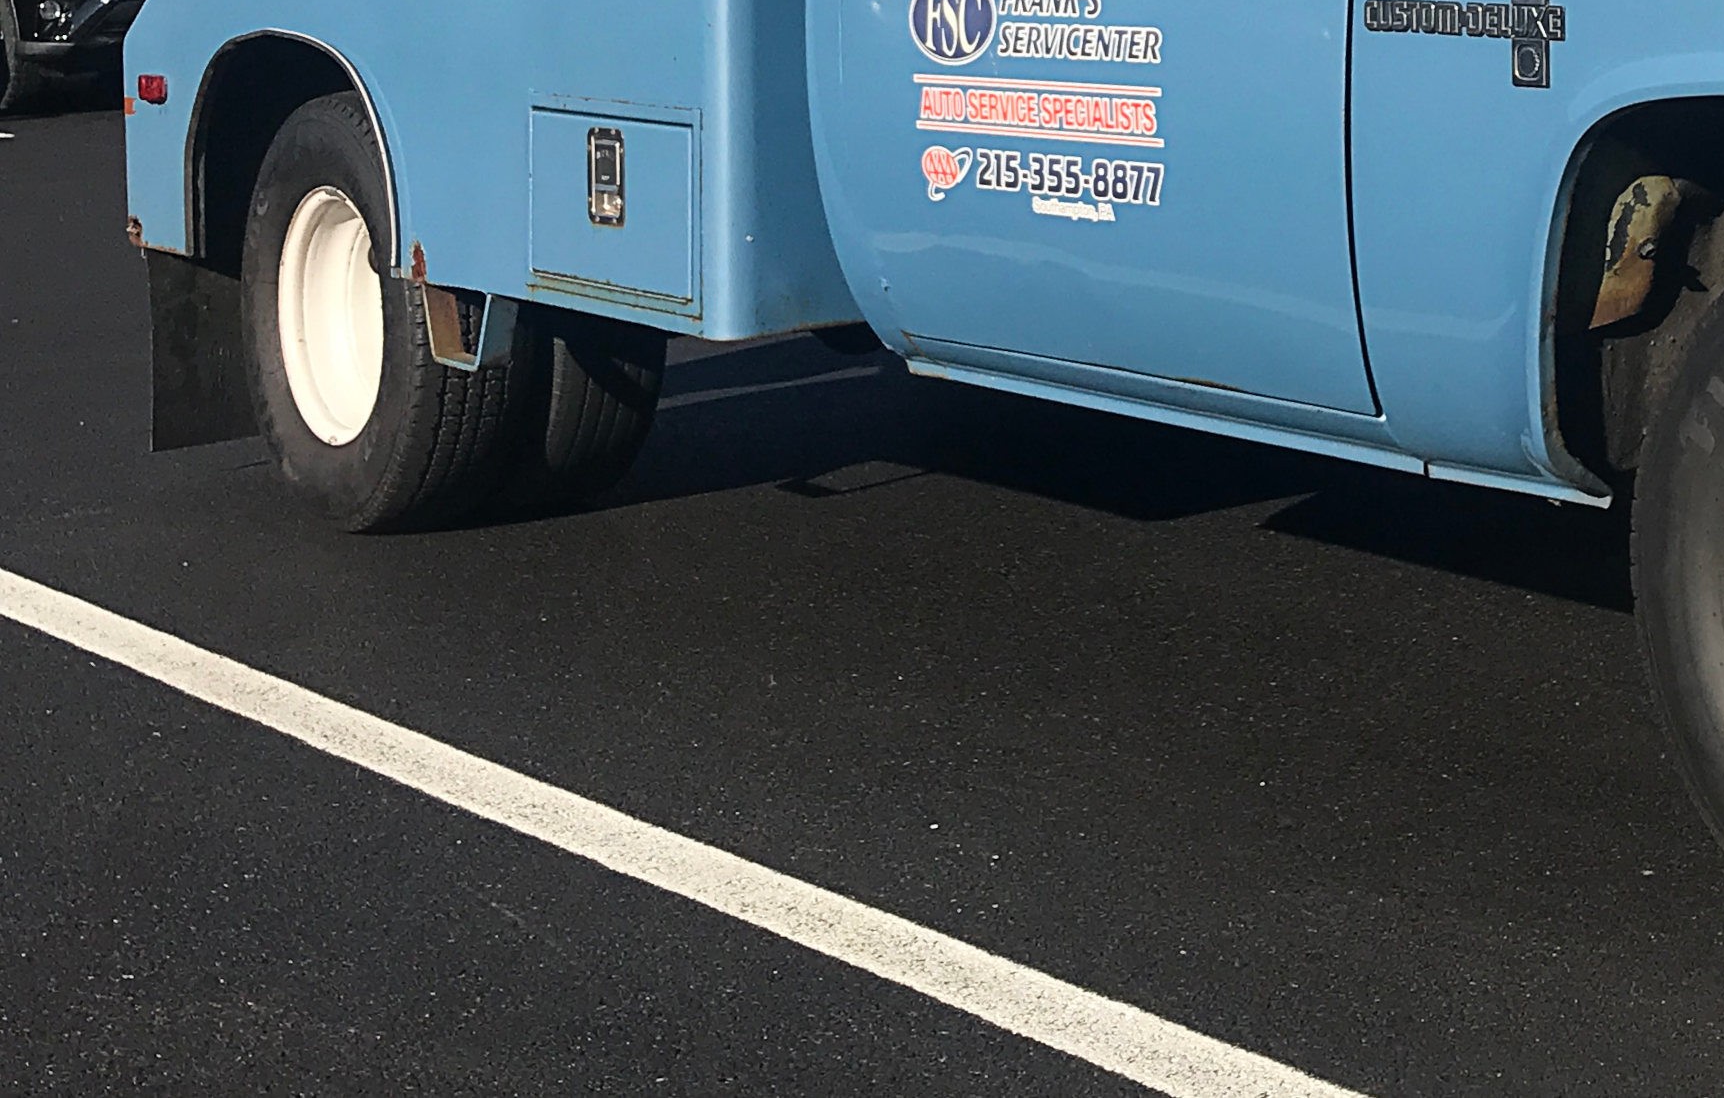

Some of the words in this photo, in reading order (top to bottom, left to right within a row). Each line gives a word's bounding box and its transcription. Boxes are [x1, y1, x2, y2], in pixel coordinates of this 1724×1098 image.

[999, 24, 1160, 61] SERVICENTER
[922, 89, 963, 119] AUTO
[968, 92, 1036, 124] SERVICE
[1041, 96, 1156, 133] SPECIALISTS
[976, 151, 1162, 203] 215-355-8877
